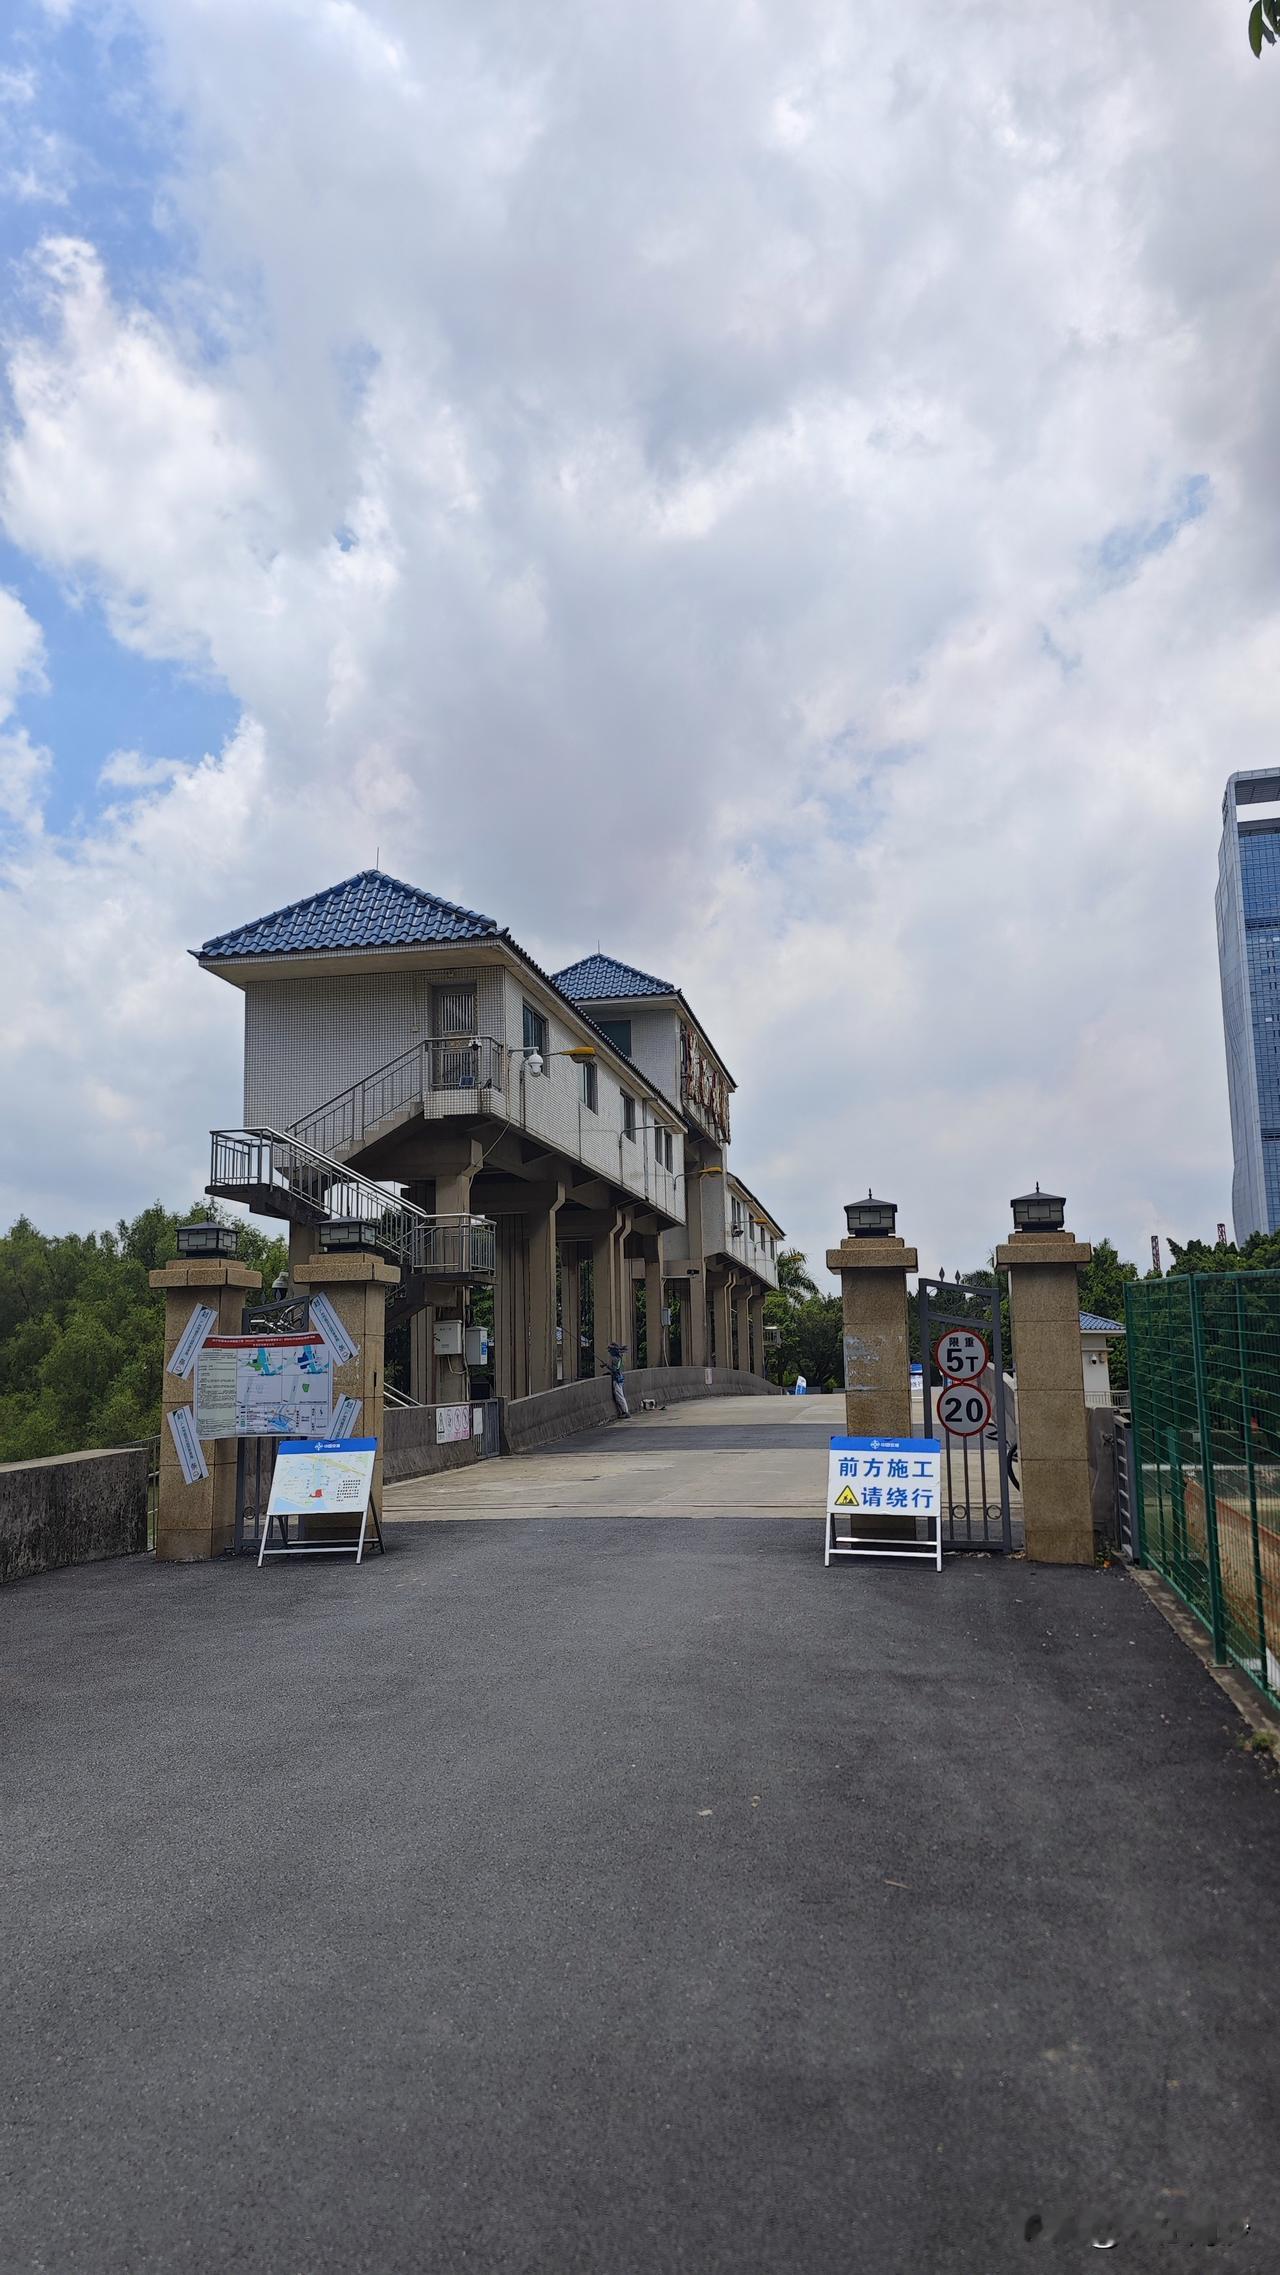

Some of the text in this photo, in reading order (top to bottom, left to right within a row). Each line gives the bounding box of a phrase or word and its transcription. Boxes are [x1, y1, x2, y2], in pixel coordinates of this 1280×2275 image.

[949, 1337, 975, 1347] 限重
[946, 1348, 979, 1372] 5T
[945, 1397, 983, 1422] 20
[838, 1457, 934, 1478] 前方施工
[861, 1486, 934, 1508] 请绕行
